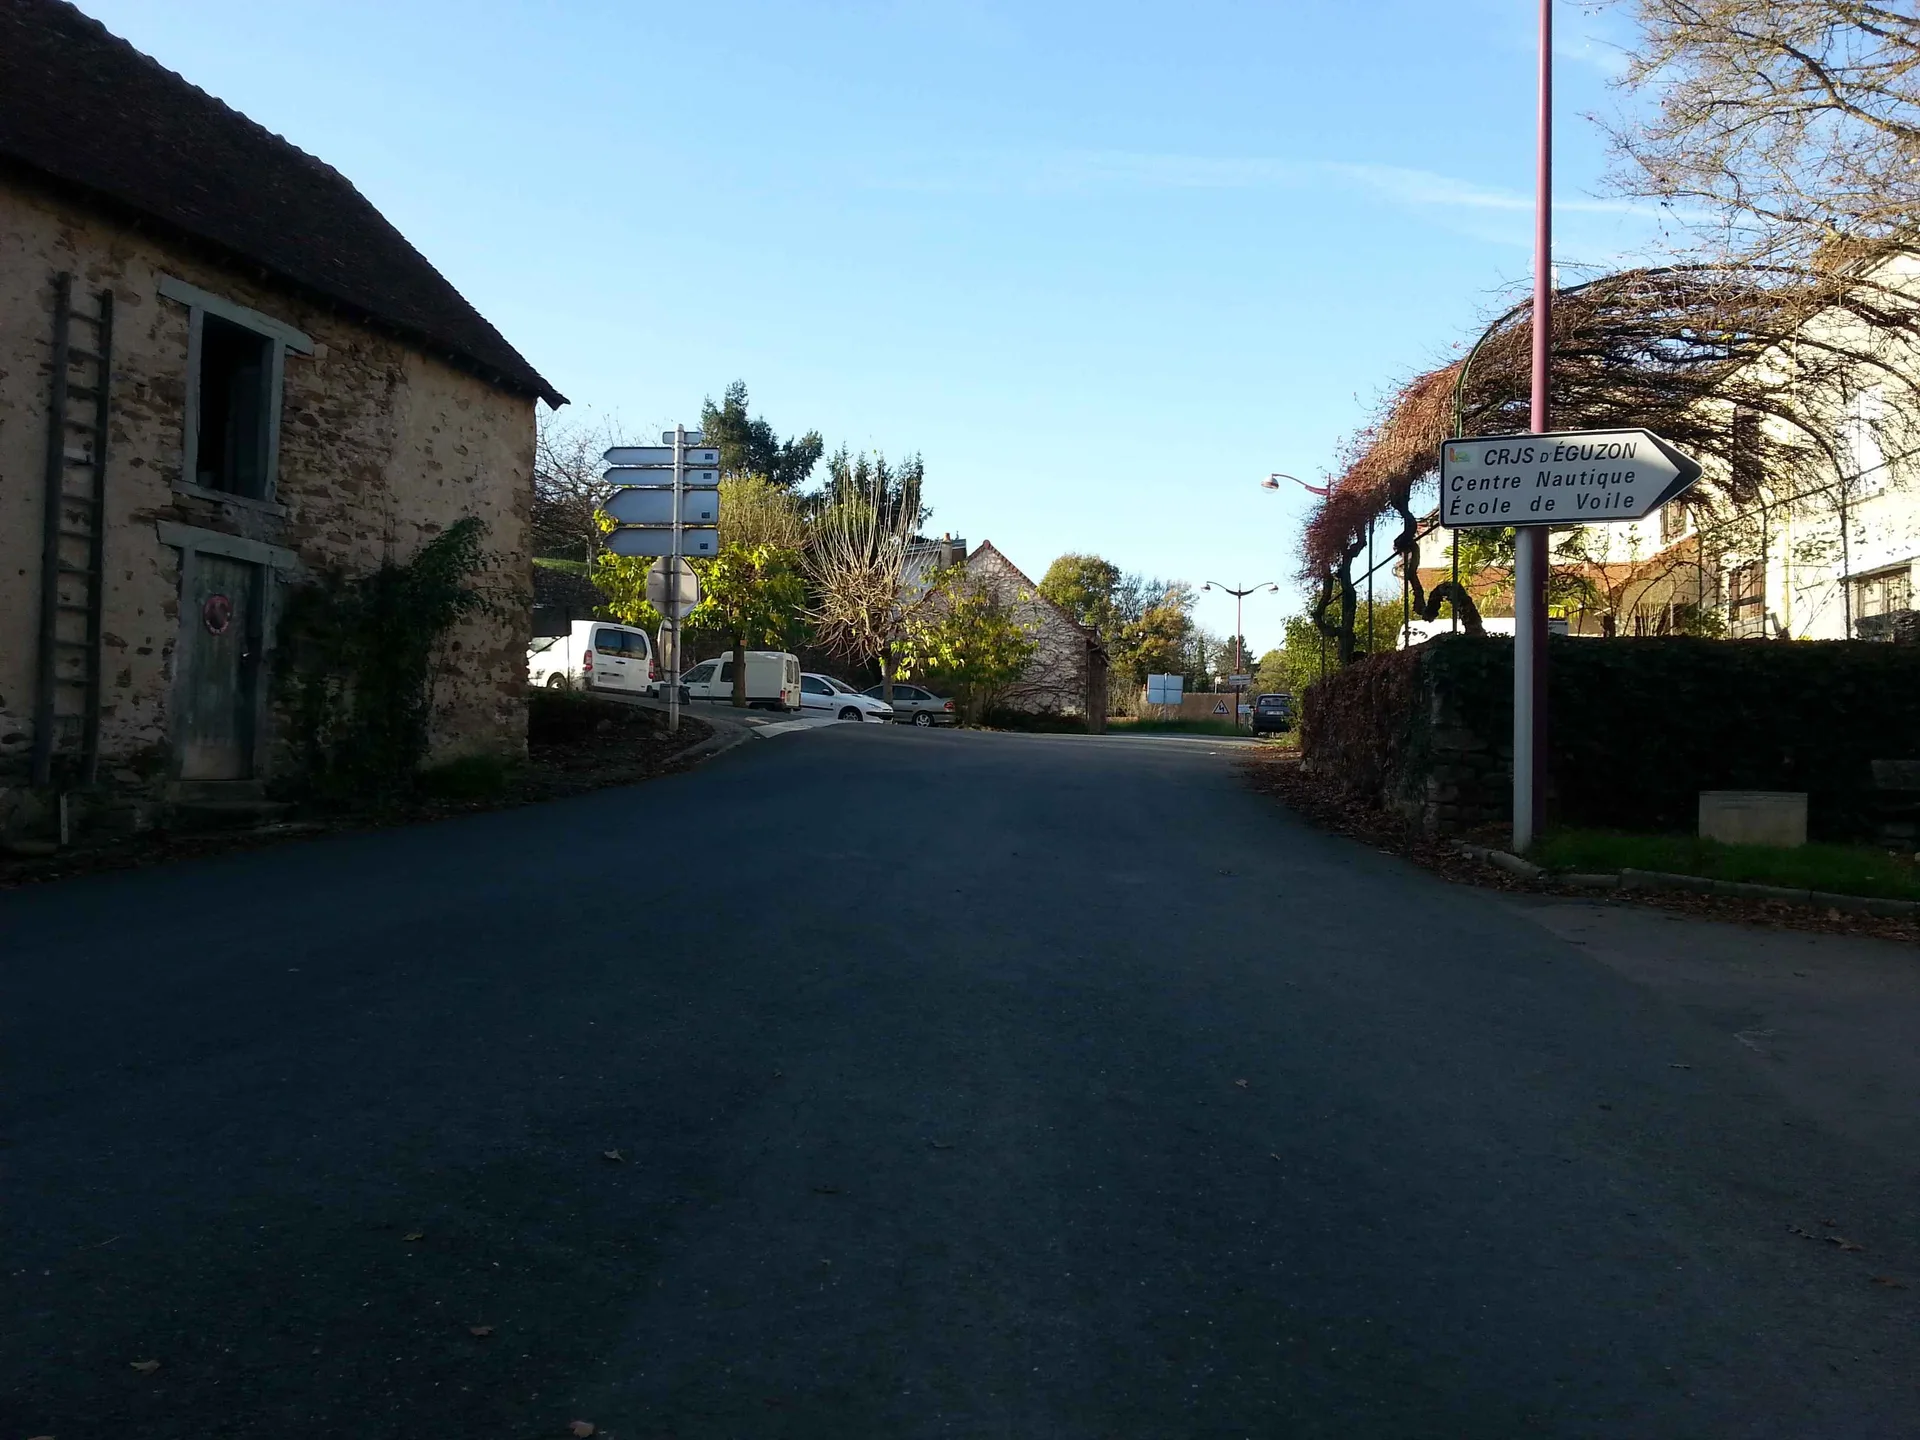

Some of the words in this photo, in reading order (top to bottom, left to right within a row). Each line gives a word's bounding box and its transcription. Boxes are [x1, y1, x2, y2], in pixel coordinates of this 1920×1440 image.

[1484, 447, 1534, 466] CRJS
[1451, 475, 1521, 492] Centre
[1536, 470, 1635, 490] Nautique
[1450, 496, 1511, 516] École
[1530, 496, 1556, 512] de
[1576, 493, 1634, 510] Voile
